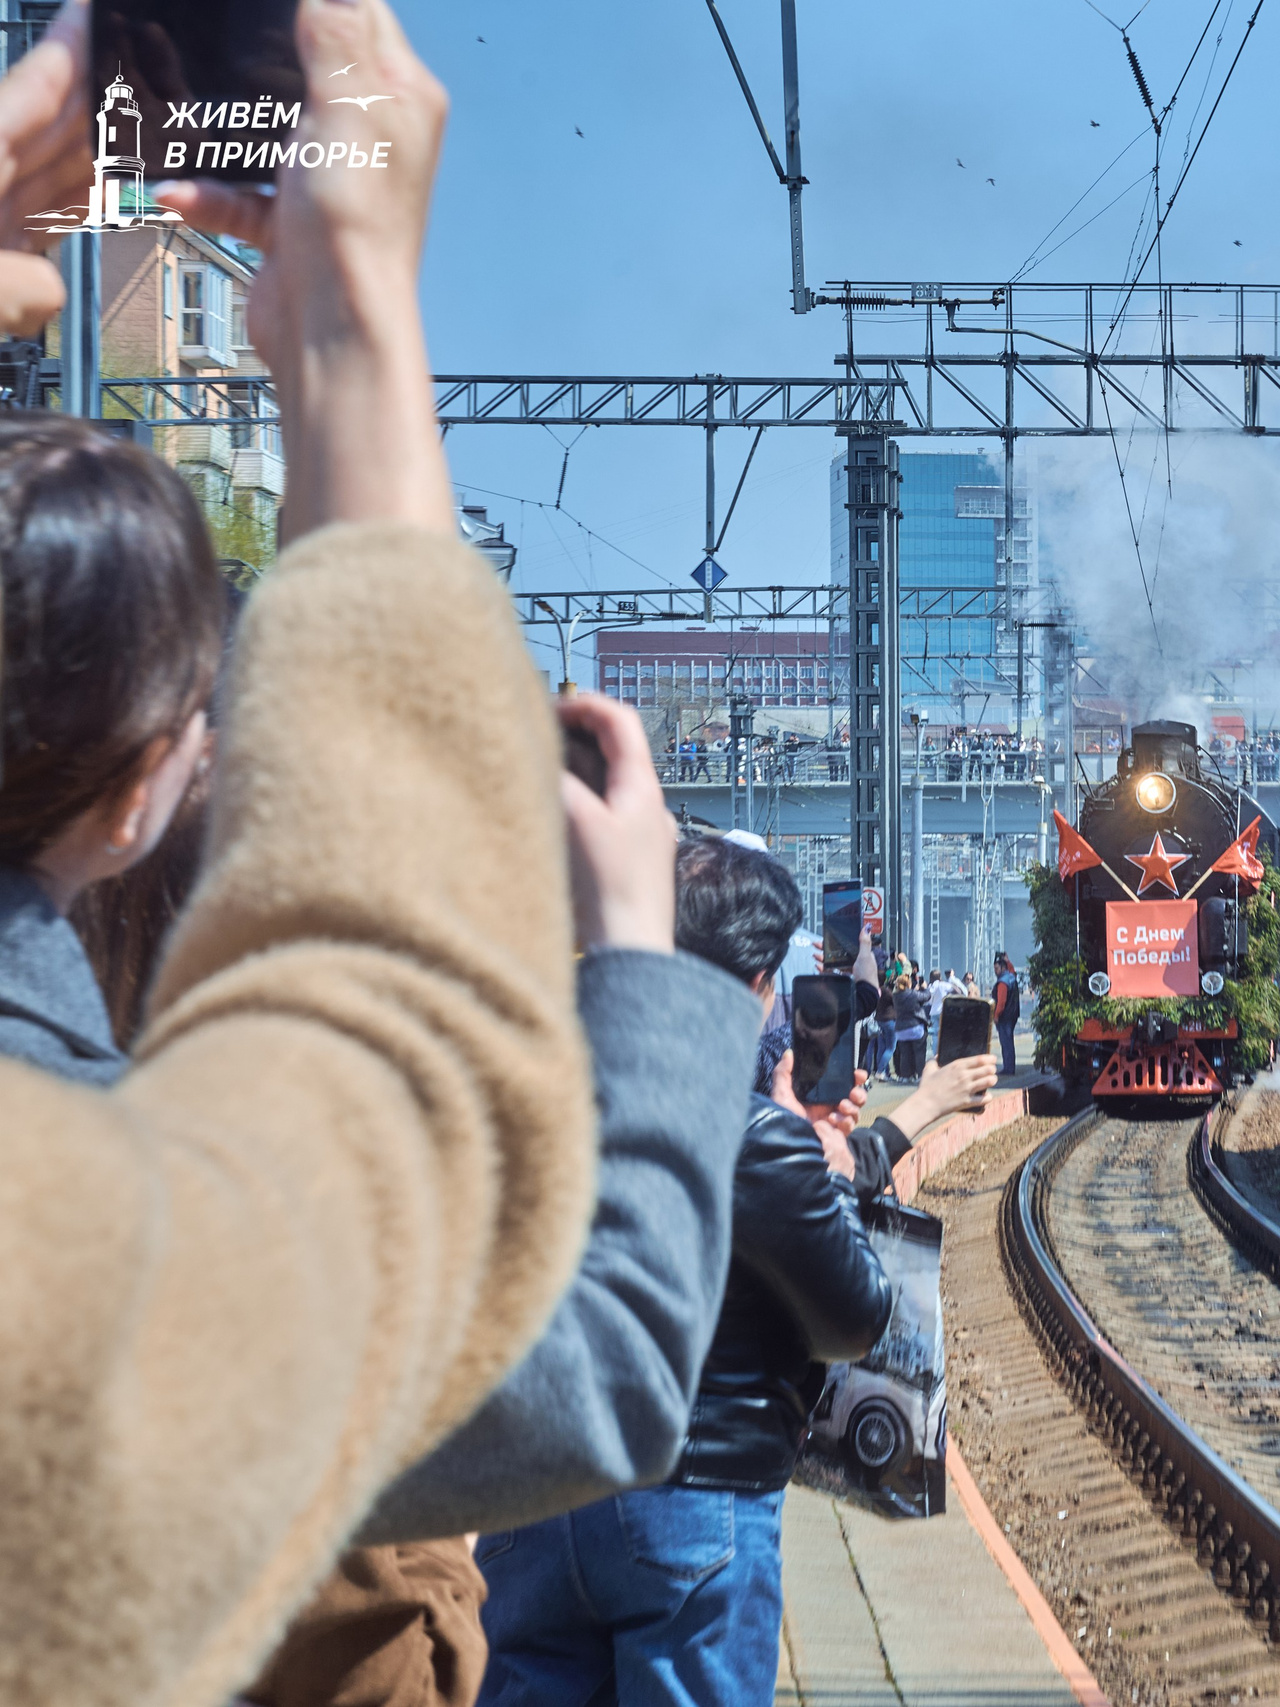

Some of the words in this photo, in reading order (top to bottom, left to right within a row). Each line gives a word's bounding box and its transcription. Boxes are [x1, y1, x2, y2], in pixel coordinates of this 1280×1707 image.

[1116, 926, 1128, 943] С
[1133, 925, 1185, 945] Днем
[1113, 945, 1191, 966] Победы!
